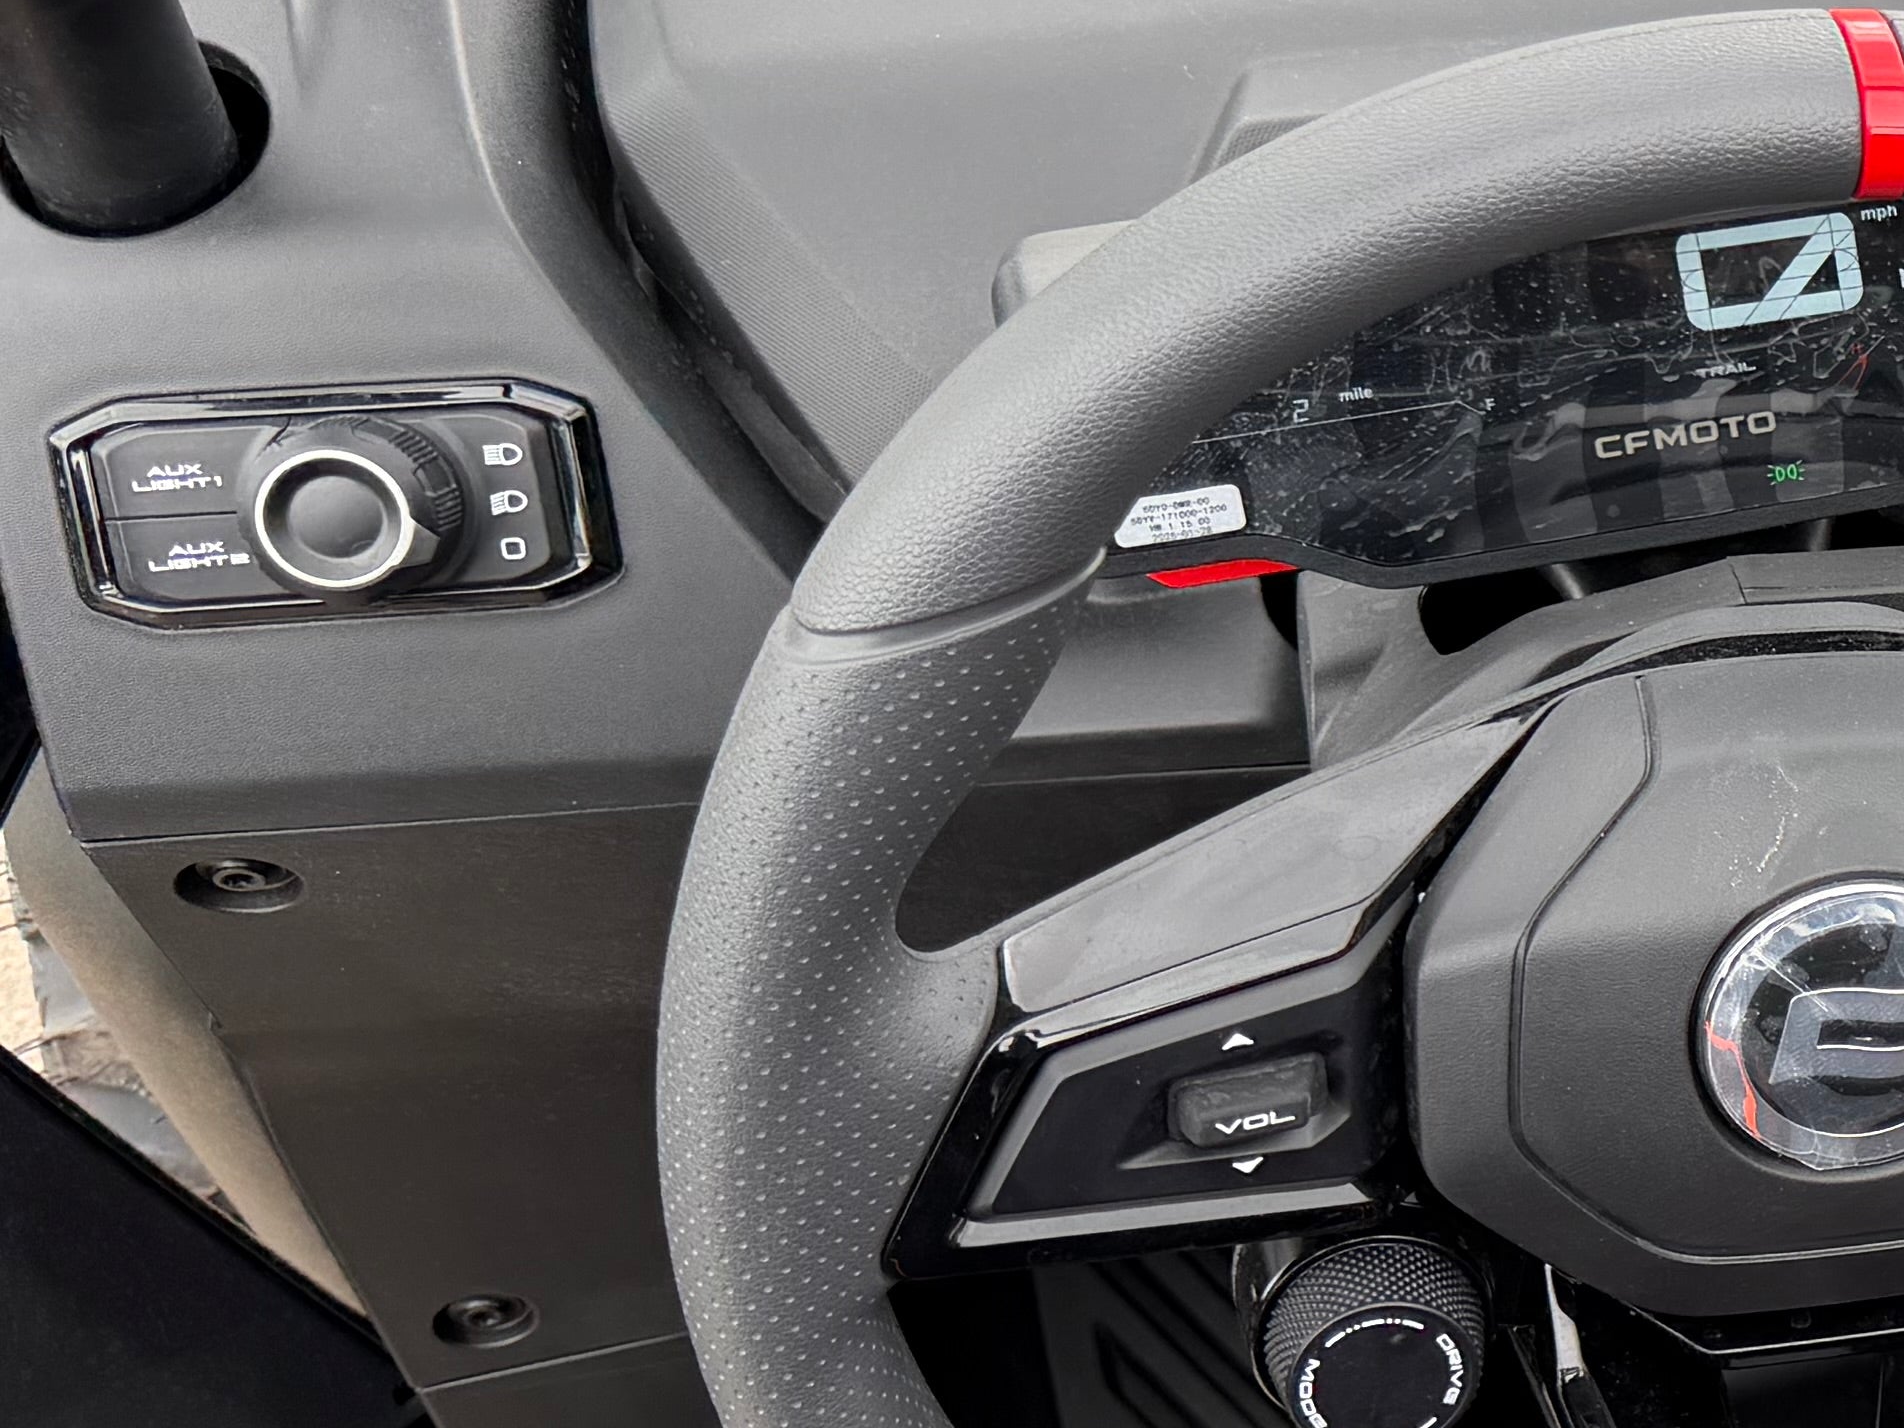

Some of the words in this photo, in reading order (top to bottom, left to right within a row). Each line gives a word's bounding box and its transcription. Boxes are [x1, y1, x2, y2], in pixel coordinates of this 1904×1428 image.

[1860, 204, 1898, 222] mph
[1338, 386, 1374, 403] mile
[1594, 410, 1777, 460] CFMOTO
[147, 463, 204, 476] AUX
[131, 475, 223, 493] LIGHT1
[168, 541, 224, 555] AUX
[149, 554, 250, 573] LIGHT2
[1214, 1110, 1296, 1135] VOL
[1435, 1333, 1464, 1405] DRIVE
